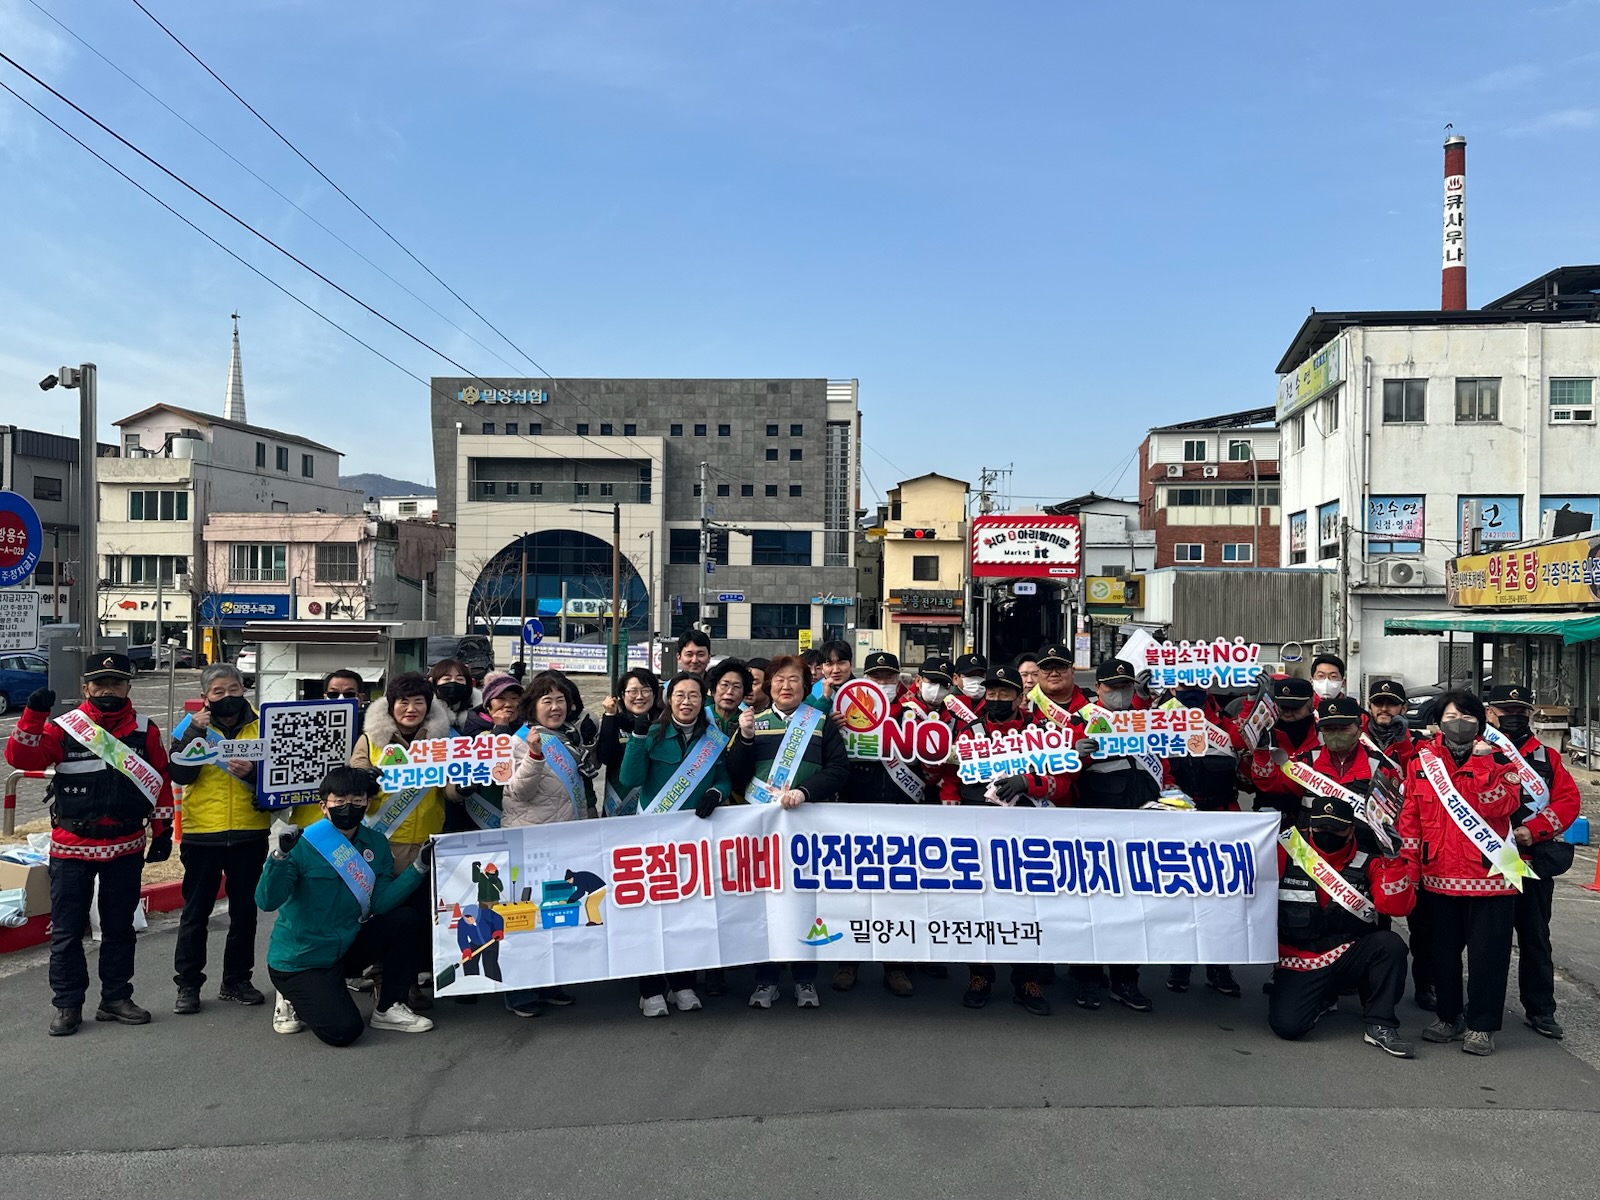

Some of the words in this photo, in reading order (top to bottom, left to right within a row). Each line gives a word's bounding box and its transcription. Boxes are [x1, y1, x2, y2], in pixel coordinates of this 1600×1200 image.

[1446, 195, 1464, 262] 큐사우나
[483, 388, 542, 404] 밀양신협
[1034, 544, 1049, 558] it
[1146, 649, 1210, 665] 불법소각
[1213, 644, 1258, 662] NO!
[1112, 711, 1146, 733] 산불
[1151, 710, 1204, 732] 조심은
[222, 743, 264, 753] 밀양시
[409, 740, 448, 763] 산불
[452, 736, 512, 760] 조심은
[883, 719, 949, 762] NO
[958, 735, 1023, 761] 불법소각
[1026, 730, 1073, 751] NO!
[1147, 733, 1186, 755] 약속
[381, 766, 444, 791] 산과의
[447, 762, 491, 786] 약속
[960, 758, 1028, 781] 산불예방
[1030, 753, 1081, 777] YES
[612, 839, 712, 906] 동절기
[719, 833, 782, 894] 대비
[790, 833, 984, 891] 안전점검으로
[991, 836, 1121, 894] 마음까지
[1131, 839, 1255, 896] 따뜻하게
[1312, 862, 1367, 912] 산불조심은
[849, 918, 916, 944] 밀양시
[927, 919, 1043, 946] 안전재난과
